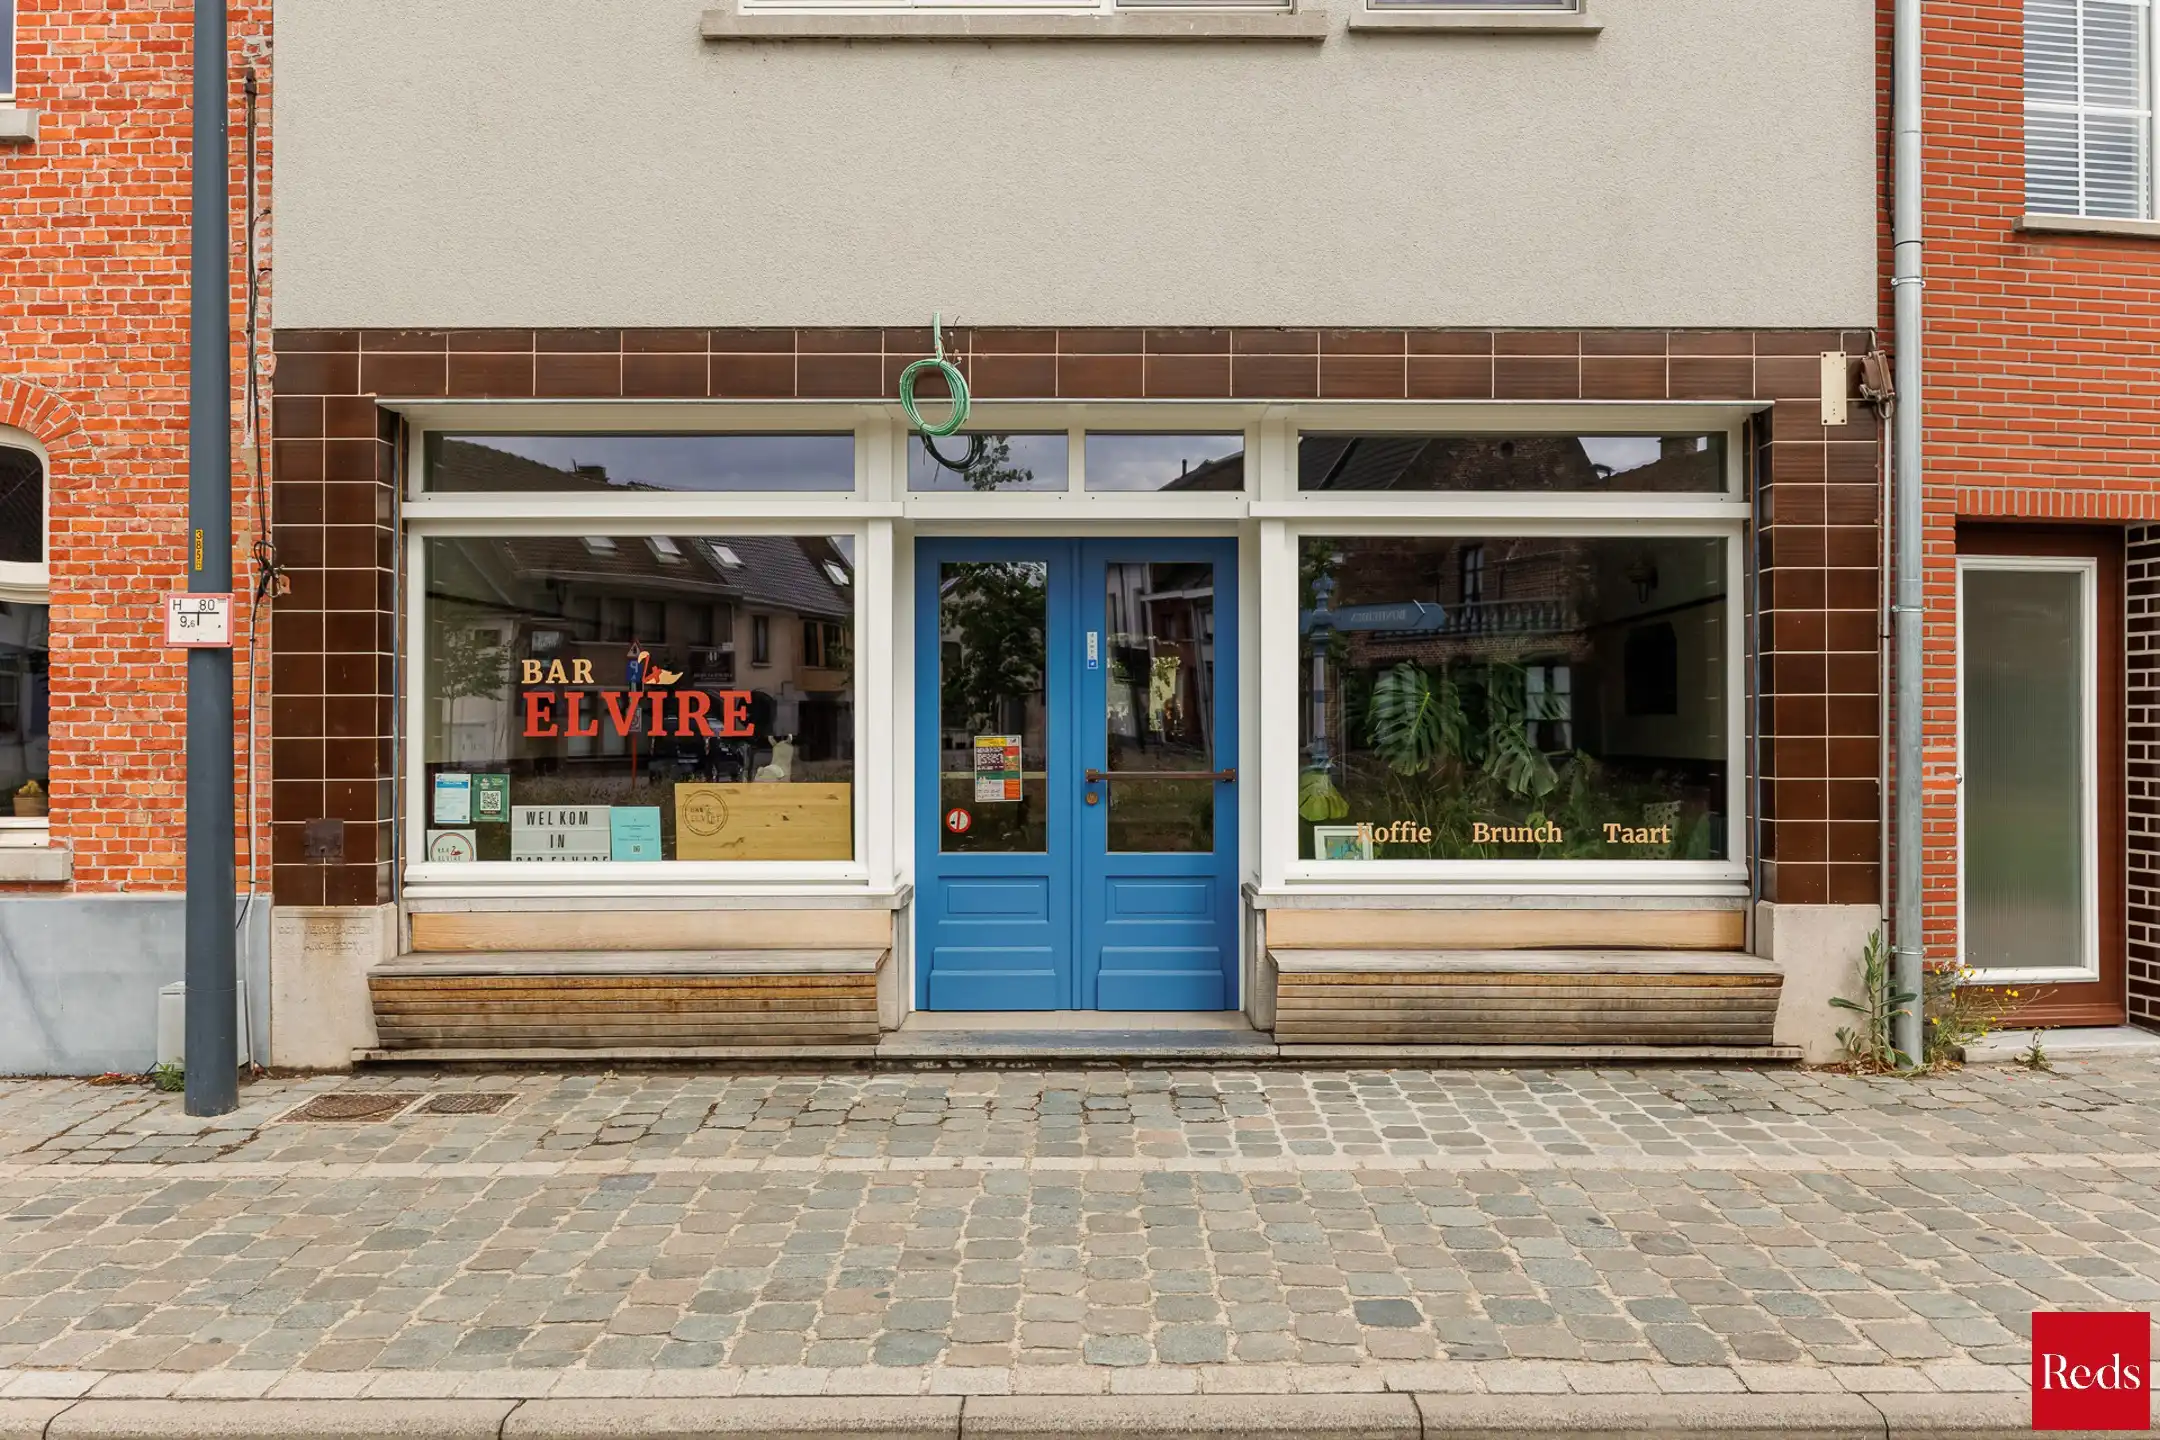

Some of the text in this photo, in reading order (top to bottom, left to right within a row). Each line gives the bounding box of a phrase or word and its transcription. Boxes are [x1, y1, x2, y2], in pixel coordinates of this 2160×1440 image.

[172, 599, 216, 611] H 80
[521, 658, 594, 684] BAR
[522, 691, 755, 737] ELVIRE
[526, 811, 589, 826] WELKOM
[550, 834, 565, 849] IN
[1356, 821, 1672, 844] Koffie Brunch Taart
